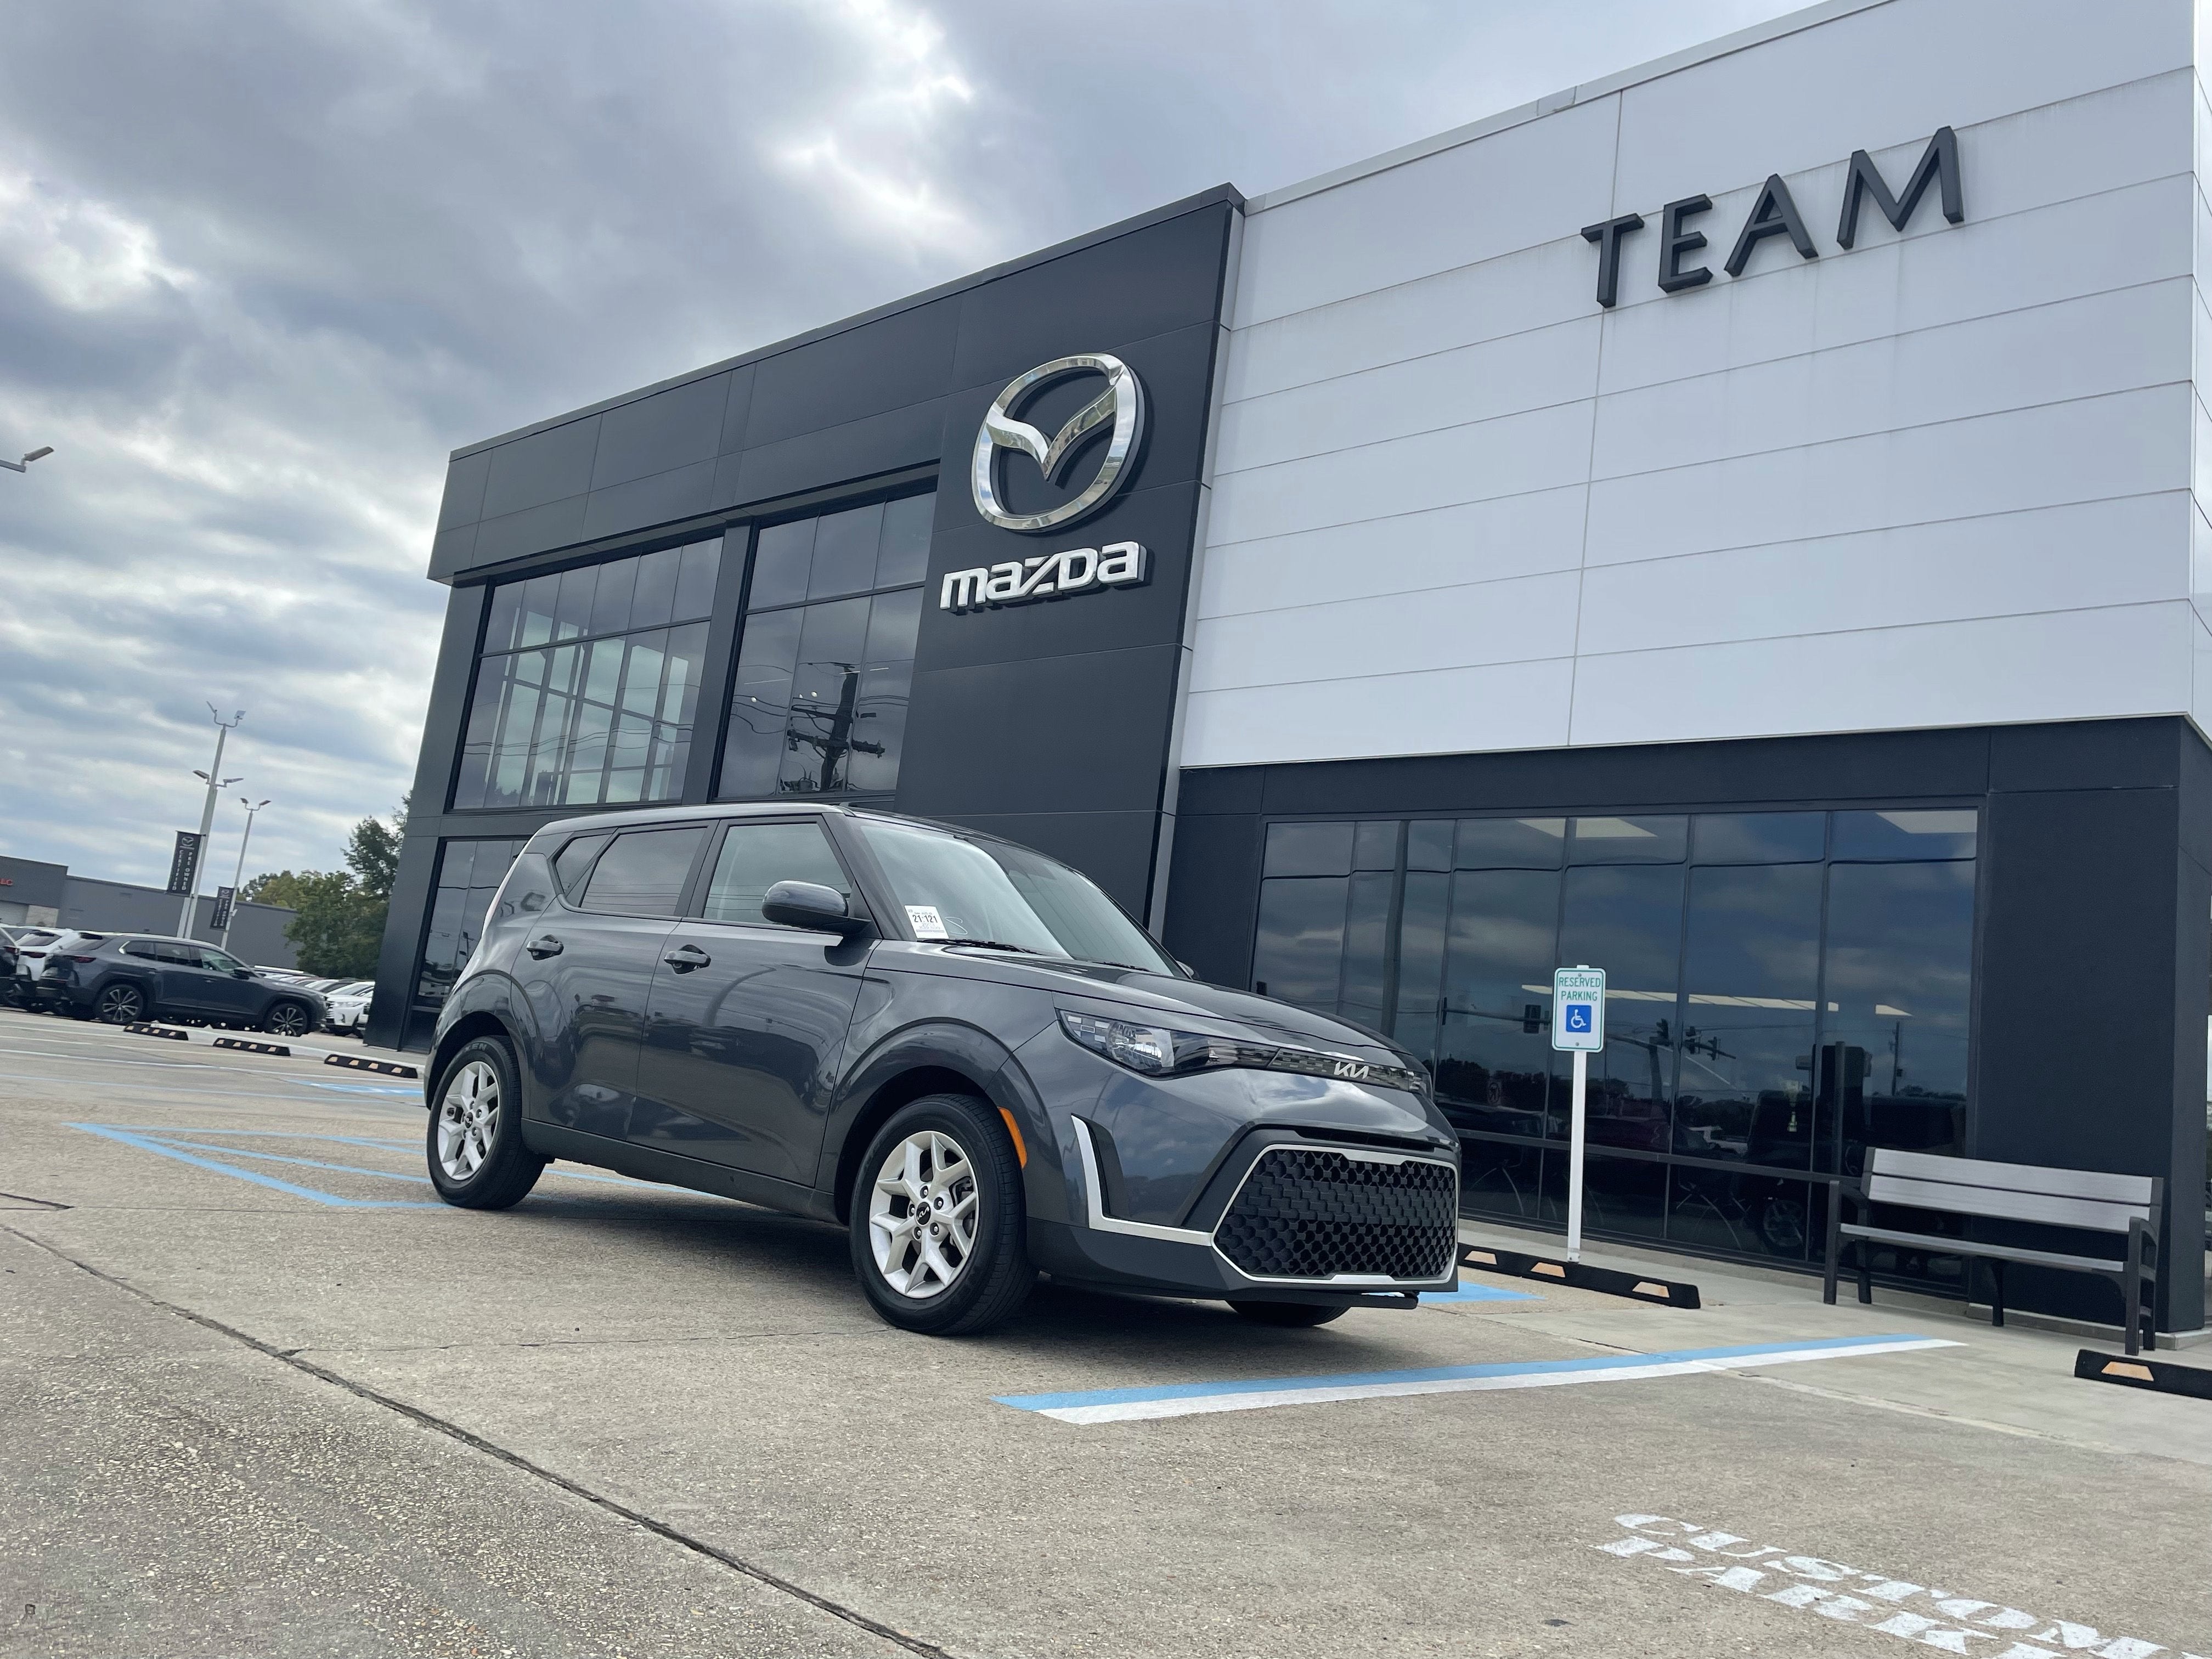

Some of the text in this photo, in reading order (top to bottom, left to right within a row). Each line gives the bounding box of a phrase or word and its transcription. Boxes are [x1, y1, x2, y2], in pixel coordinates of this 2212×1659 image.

[1581, 126, 1964, 308] TEAM
[1559, 977, 1601, 988] RESERVED
[1561, 991, 1598, 1001] PARKING
[1614, 1513, 2212, 1659] CUSTOM
